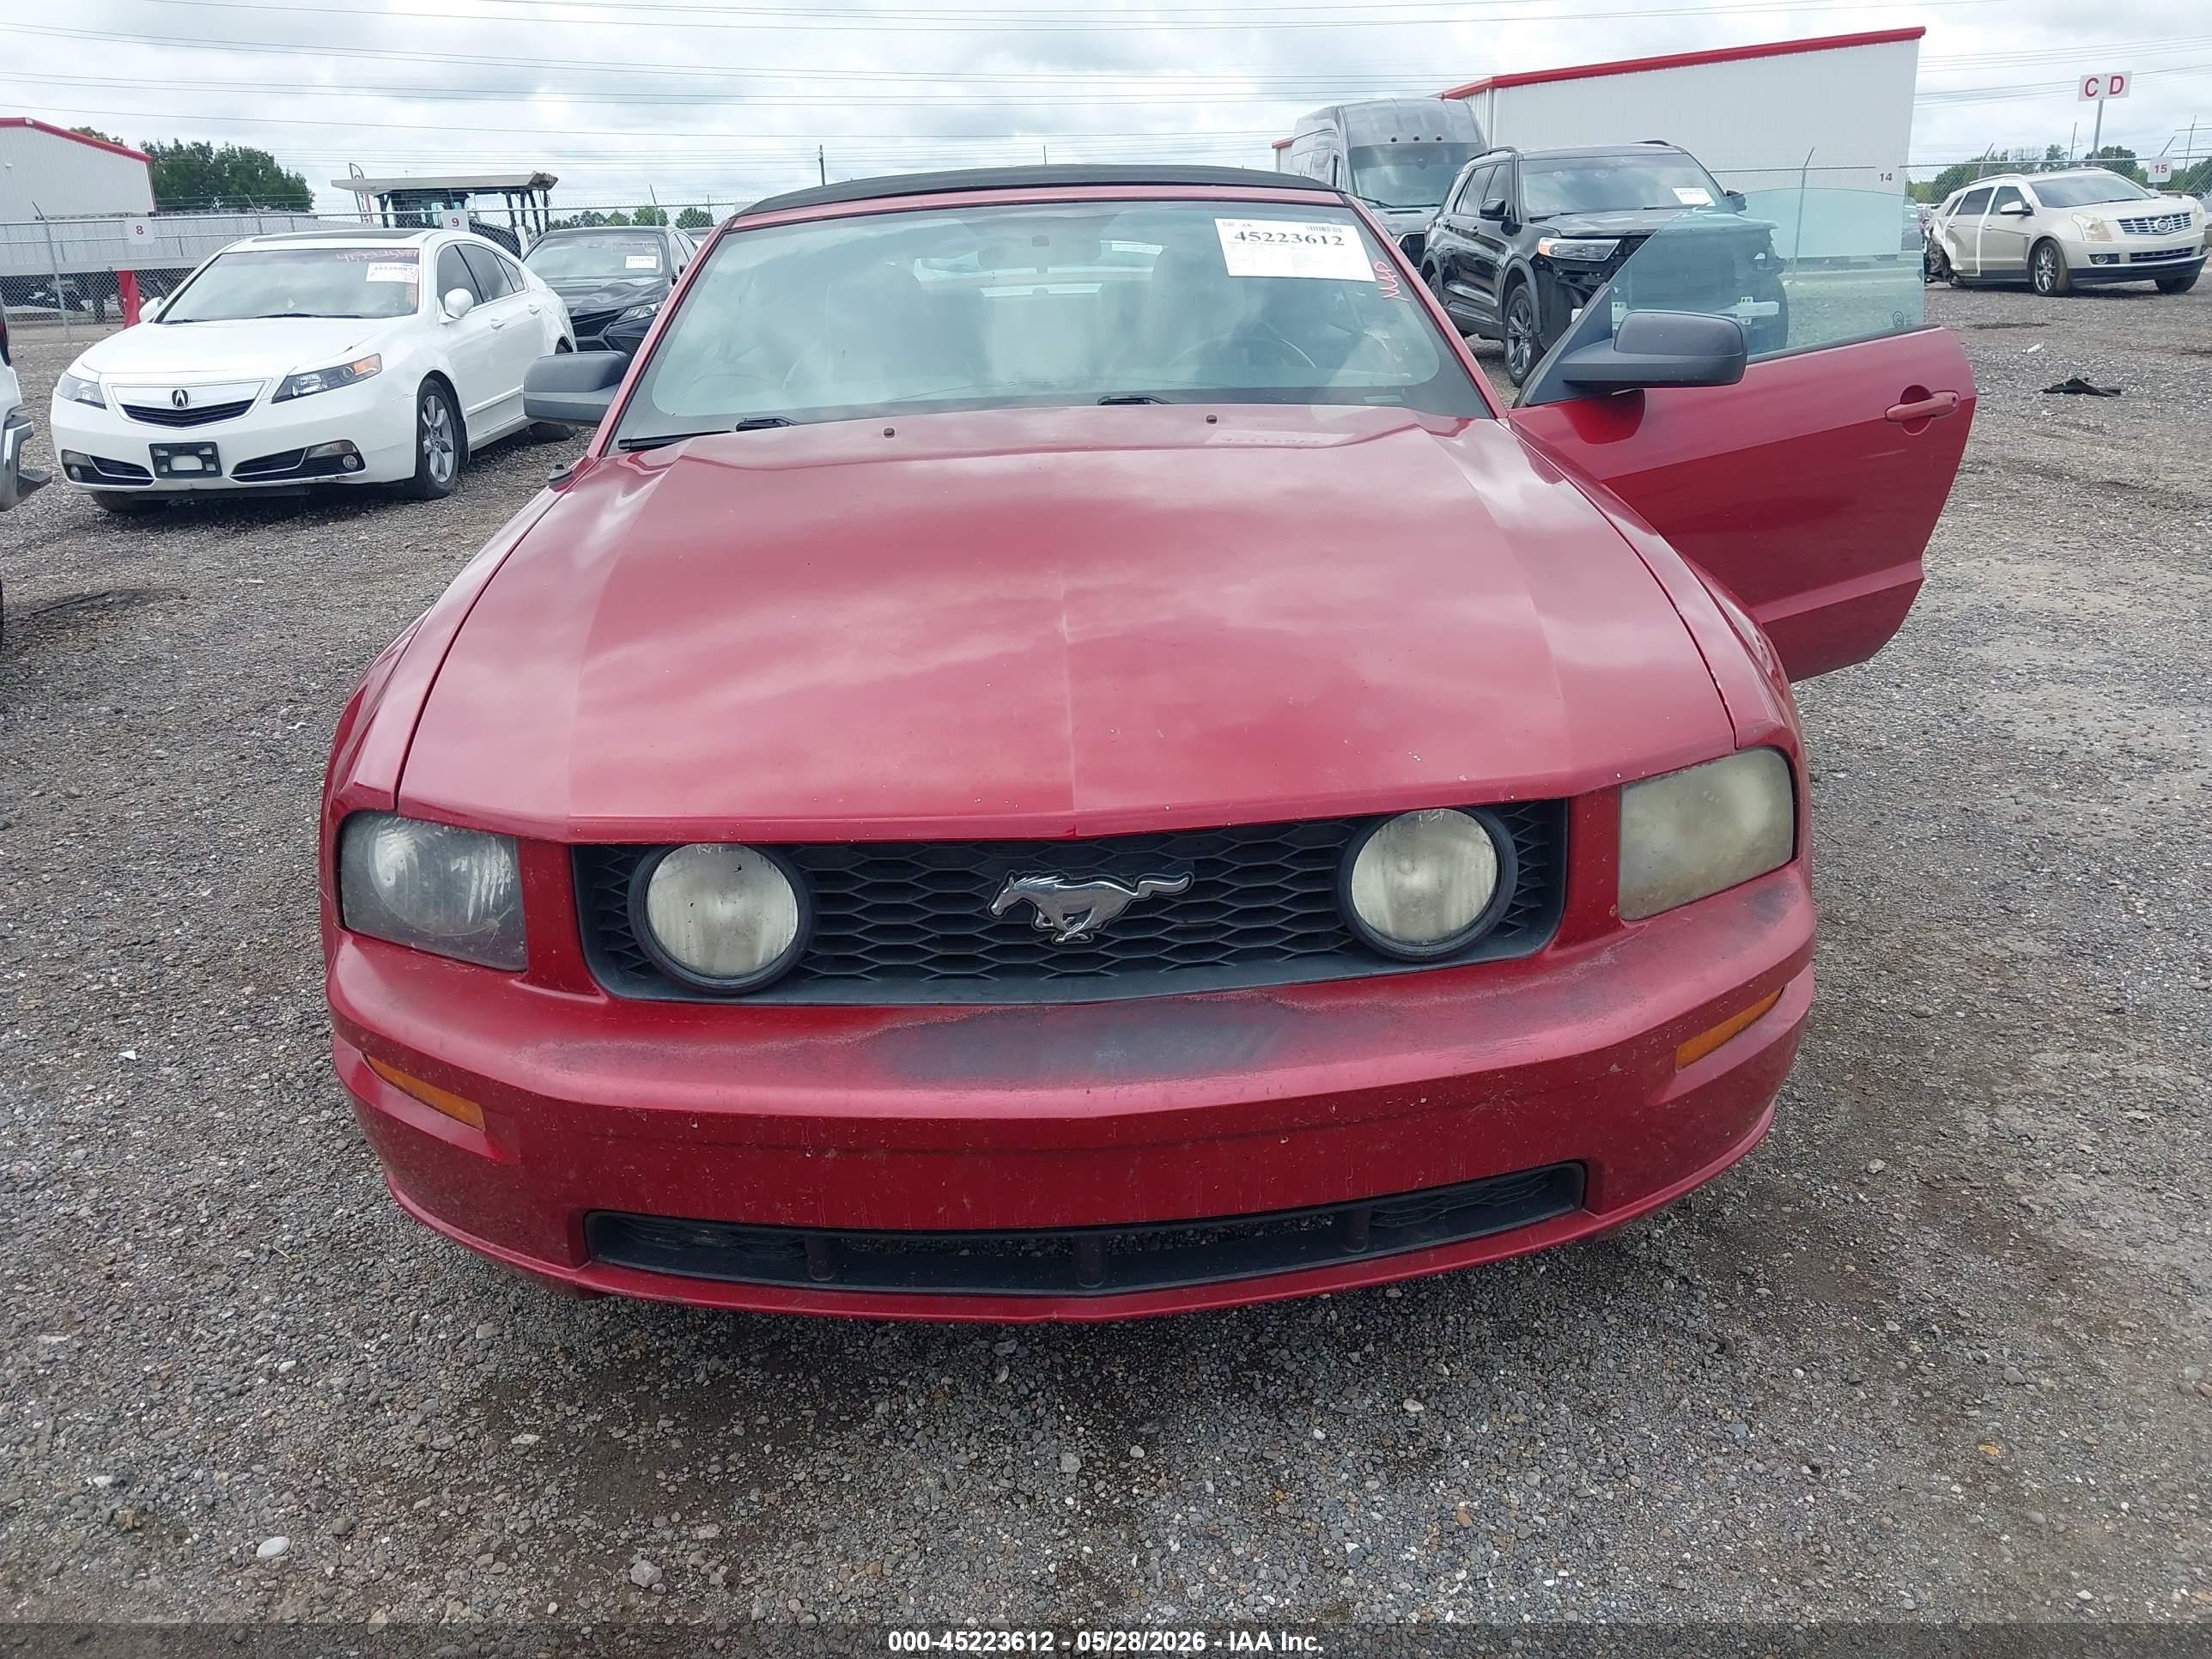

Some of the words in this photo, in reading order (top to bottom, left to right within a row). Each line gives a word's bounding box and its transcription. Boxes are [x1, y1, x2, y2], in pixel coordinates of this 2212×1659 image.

[2084, 77, 2100, 97] C
[2108, 75, 2124, 95] D
[2154, 164, 2168, 173] 15
[1879, 172, 1893, 182] 14
[452, 217, 460, 228] 9
[136, 225, 144, 235] 8
[1234, 230, 1346, 246] 45223612
